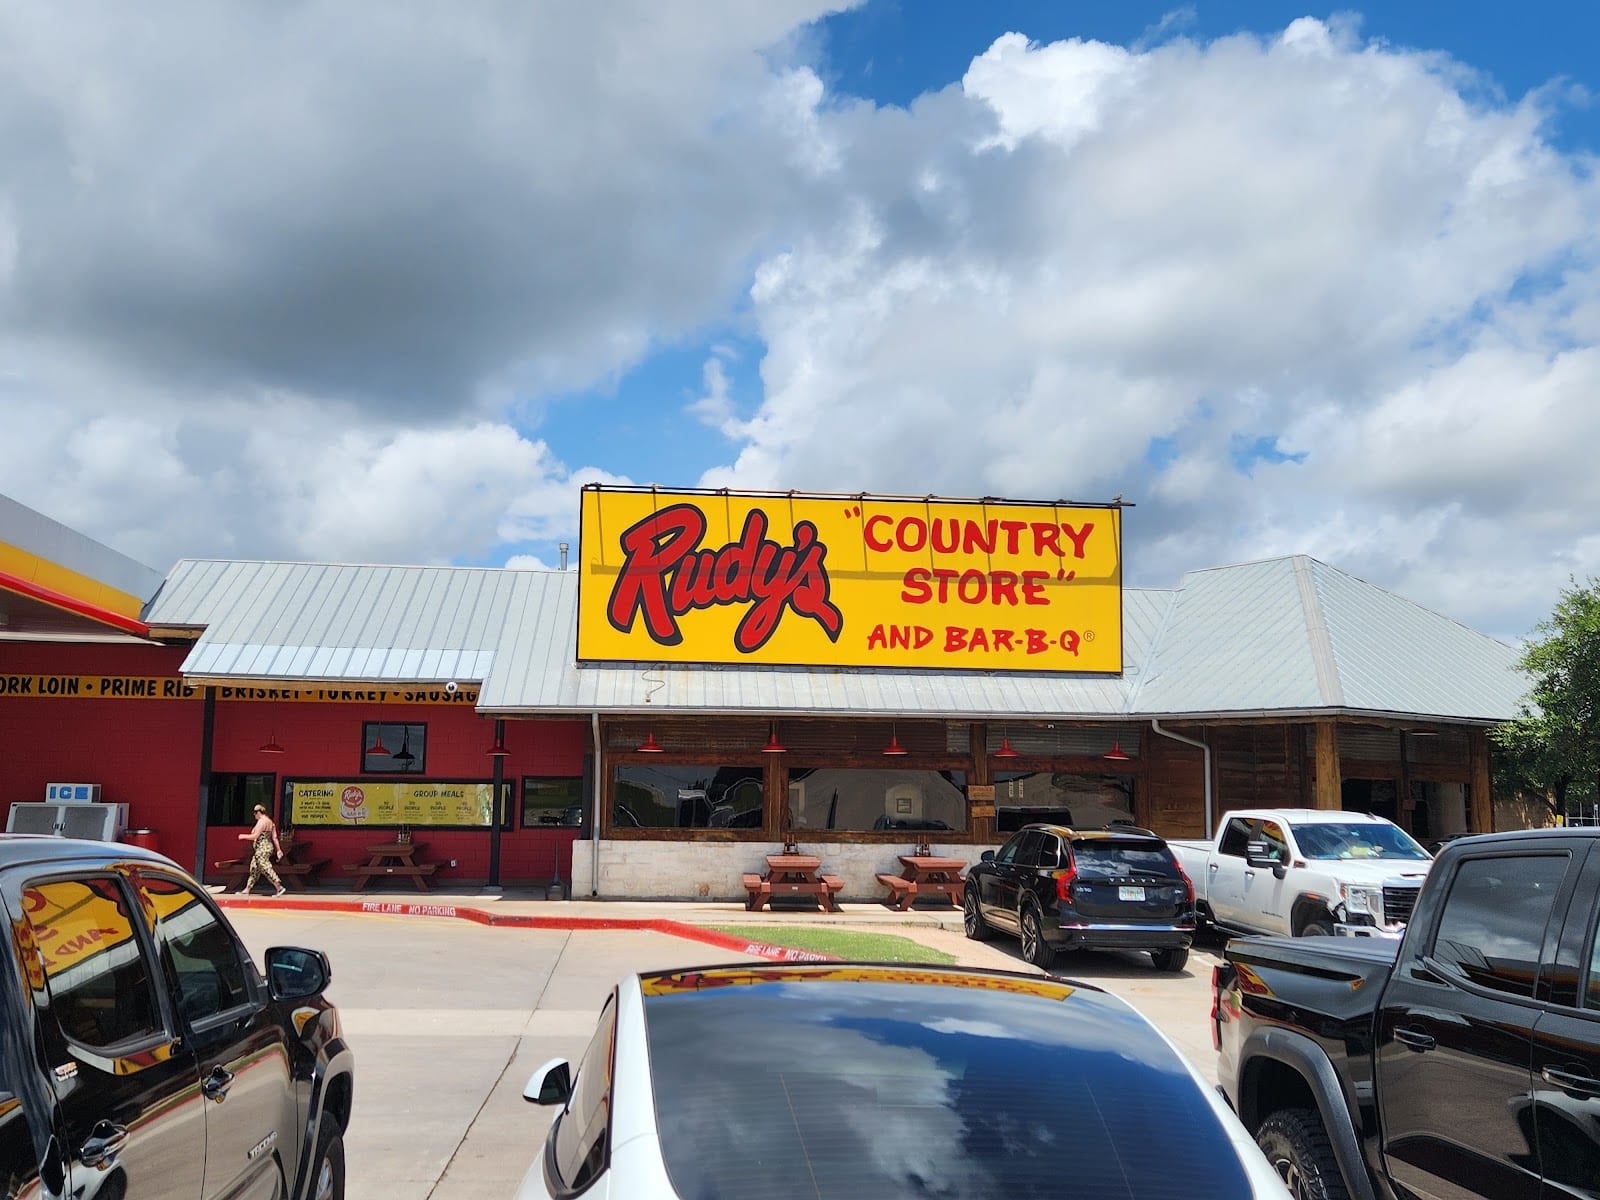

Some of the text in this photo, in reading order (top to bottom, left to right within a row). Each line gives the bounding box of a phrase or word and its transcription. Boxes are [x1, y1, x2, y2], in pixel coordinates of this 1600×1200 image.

[607, 503, 843, 653] Rudy's
[868, 624, 934, 650] AND
[38, 677, 79, 694] LOIN
[100, 678, 157, 696] PRIME
[163, 680, 195, 697] RIB
[49, 786, 89, 800] ICE
[298, 789, 334, 798] CATERING
[413, 790, 465, 798] GROUP MEALS
[362, 902, 456, 917] FIRE LANE NO PARKING
[762, 945, 782, 957] LANE
[784, 949, 799, 961] NO
